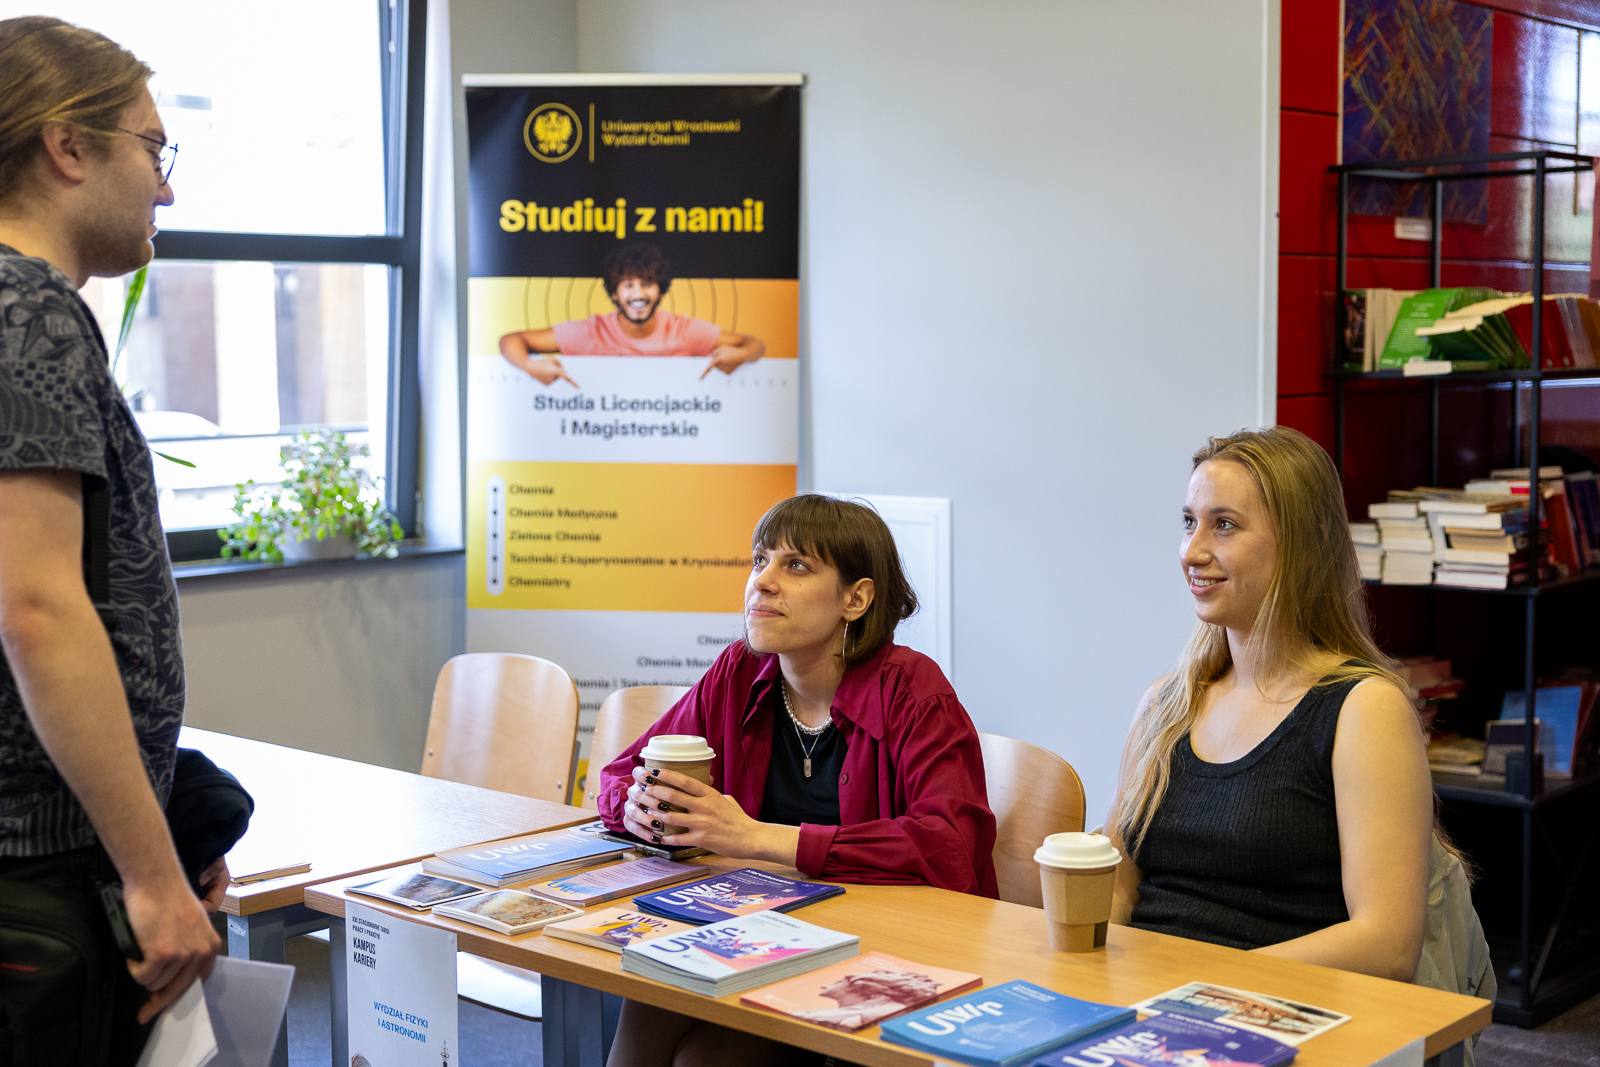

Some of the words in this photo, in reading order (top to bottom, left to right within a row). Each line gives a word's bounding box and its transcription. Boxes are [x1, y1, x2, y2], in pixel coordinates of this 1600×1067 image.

[601, 119, 671, 133] Uniwersytet
[672, 119, 741, 133] Wrocławski
[648, 132, 691, 146] Chemii
[499, 197, 626, 239] Studiuj
[635, 207, 657, 232] z
[665, 198, 764, 233] nami!
[533, 394, 595, 413] Studia
[601, 394, 722, 416] Licencjackie
[561, 419, 566, 435] i
[571, 420, 699, 440] Magisterskie
[508, 484, 555, 496] Chemia
[508, 507, 555, 519] Chemia
[557, 508, 619, 522] Medyczna
[509, 530, 552, 541] Zielona
[555, 530, 602, 542] Chemia
[510, 553, 559, 565] Techniki
[508, 575, 572, 590] Chemistry
[637, 655, 682, 668] Chemia
[575, 677, 610, 688] hemia
[467, 841, 550, 861] UWr
[654, 881, 734, 905] UWr
[617, 913, 669, 928] UWr
[353, 936, 376, 955] KAMPUS
[649, 926, 740, 953] UWr
[353, 951, 377, 970] KARIERY
[373, 1000, 404, 1021] WYDZIAŁ
[405, 1012, 428, 1029] FIZYKI
[907, 1001, 1003, 1036] UWr
[381, 1019, 426, 1043] ASTRONOMII
[1062, 1031, 1159, 1067] UWr
